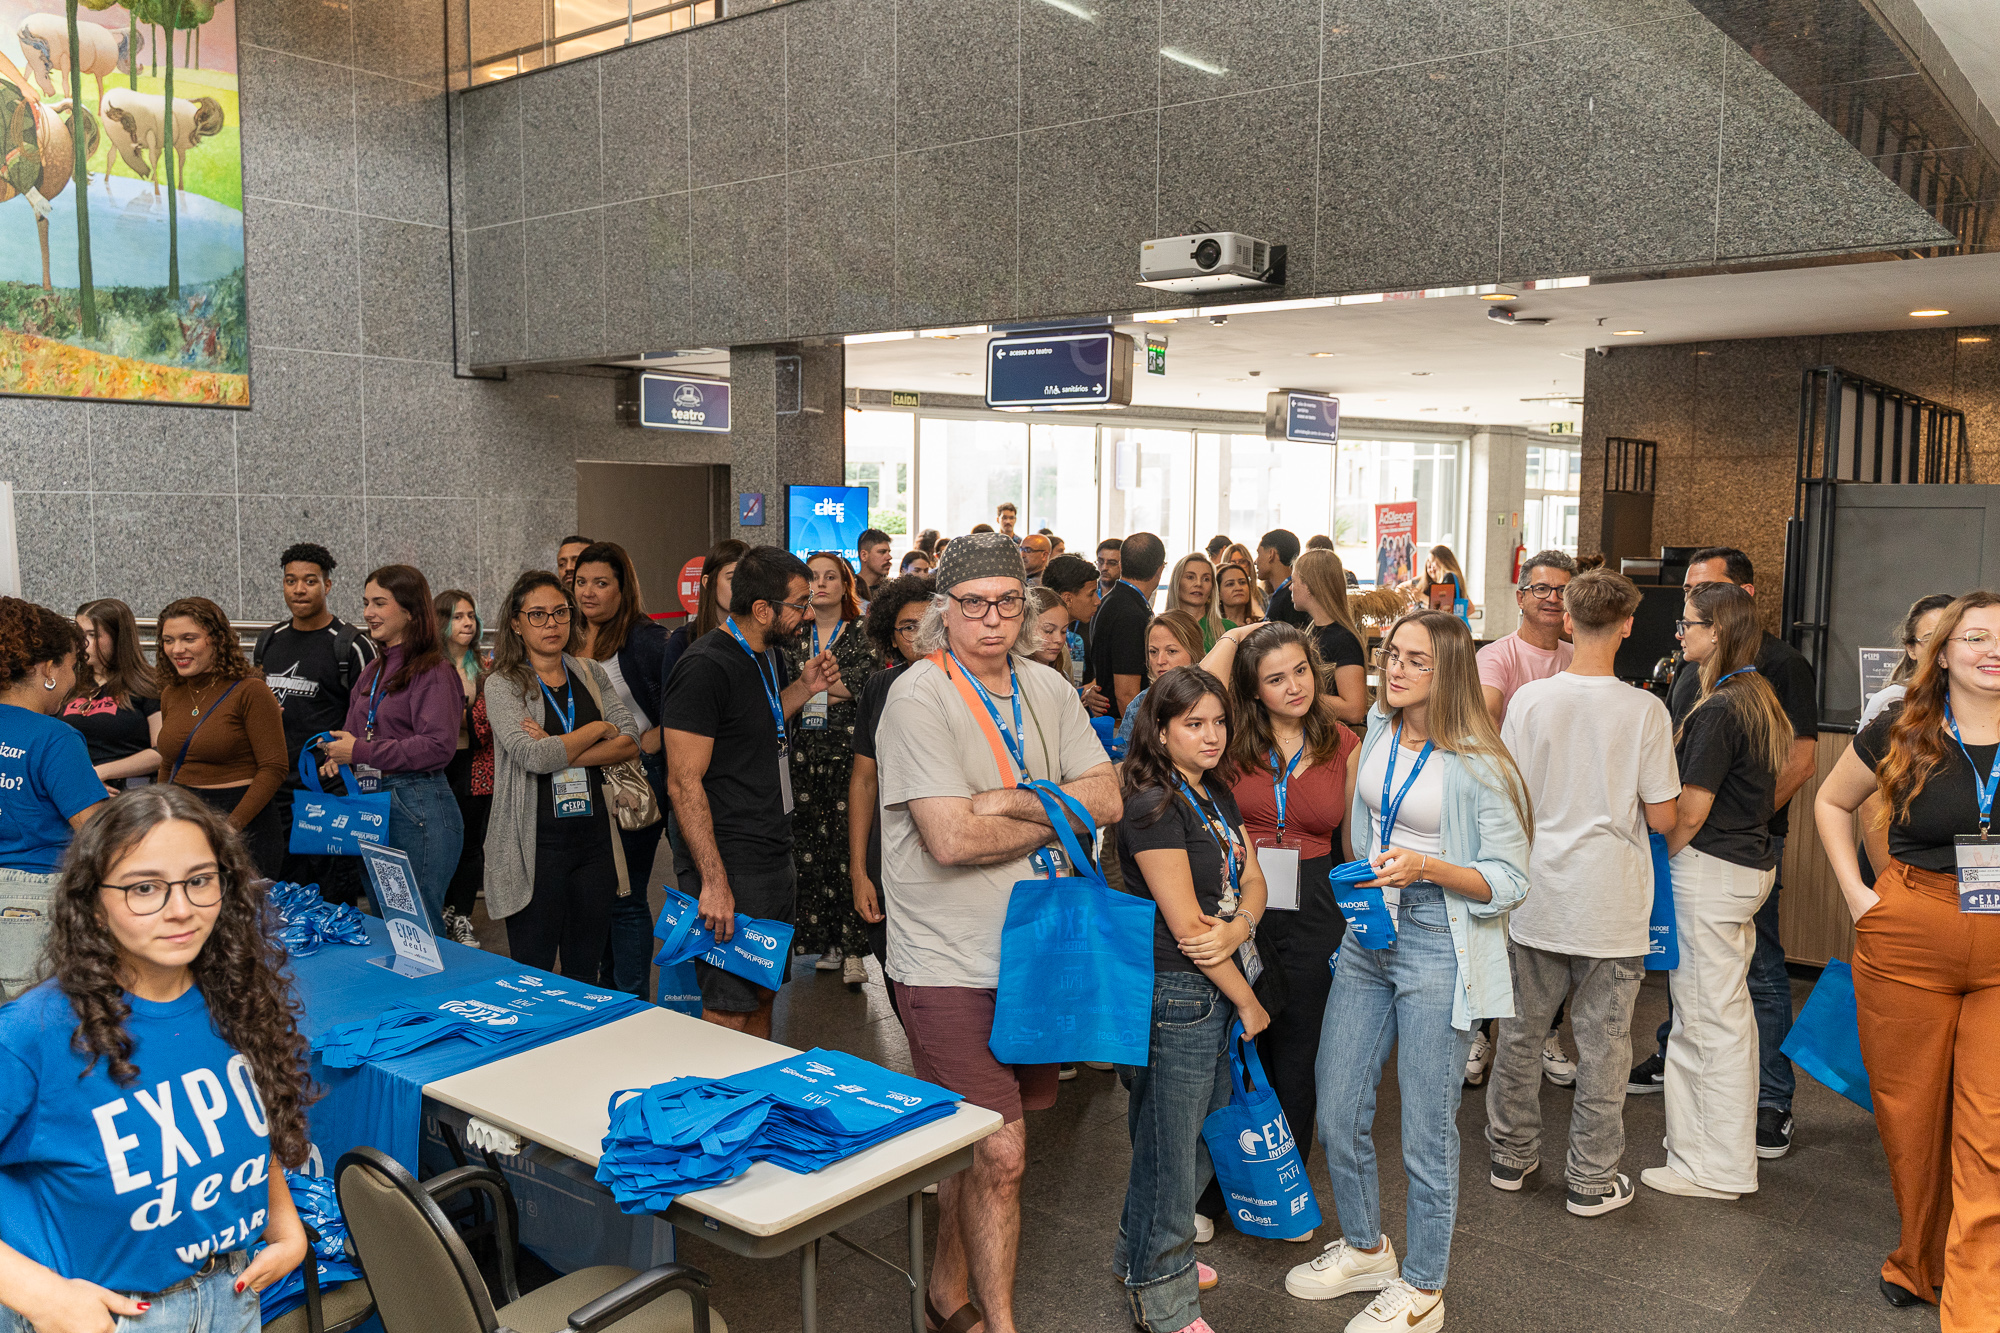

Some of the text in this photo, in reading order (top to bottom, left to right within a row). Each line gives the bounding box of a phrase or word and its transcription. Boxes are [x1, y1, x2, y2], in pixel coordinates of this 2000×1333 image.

[1062, 385, 1089, 393] sanitários
[894, 393, 917, 406] SAÍDA
[671, 407, 706, 421] teatro
[569, 801, 586, 810] EXPO
[331, 815, 349, 829] EF
[395, 922, 420, 943] EXPO
[745, 930, 777, 950] Quest
[403, 939, 427, 953] deals
[734, 945, 774, 968] Global Village
[438, 1000, 502, 1023] EXPO
[91, 1053, 270, 1196] EXPO
[1231, 1192, 1278, 1206] Global Village
[1291, 1192, 1308, 1214] EF
[1238, 1208, 1272, 1224] Quest
